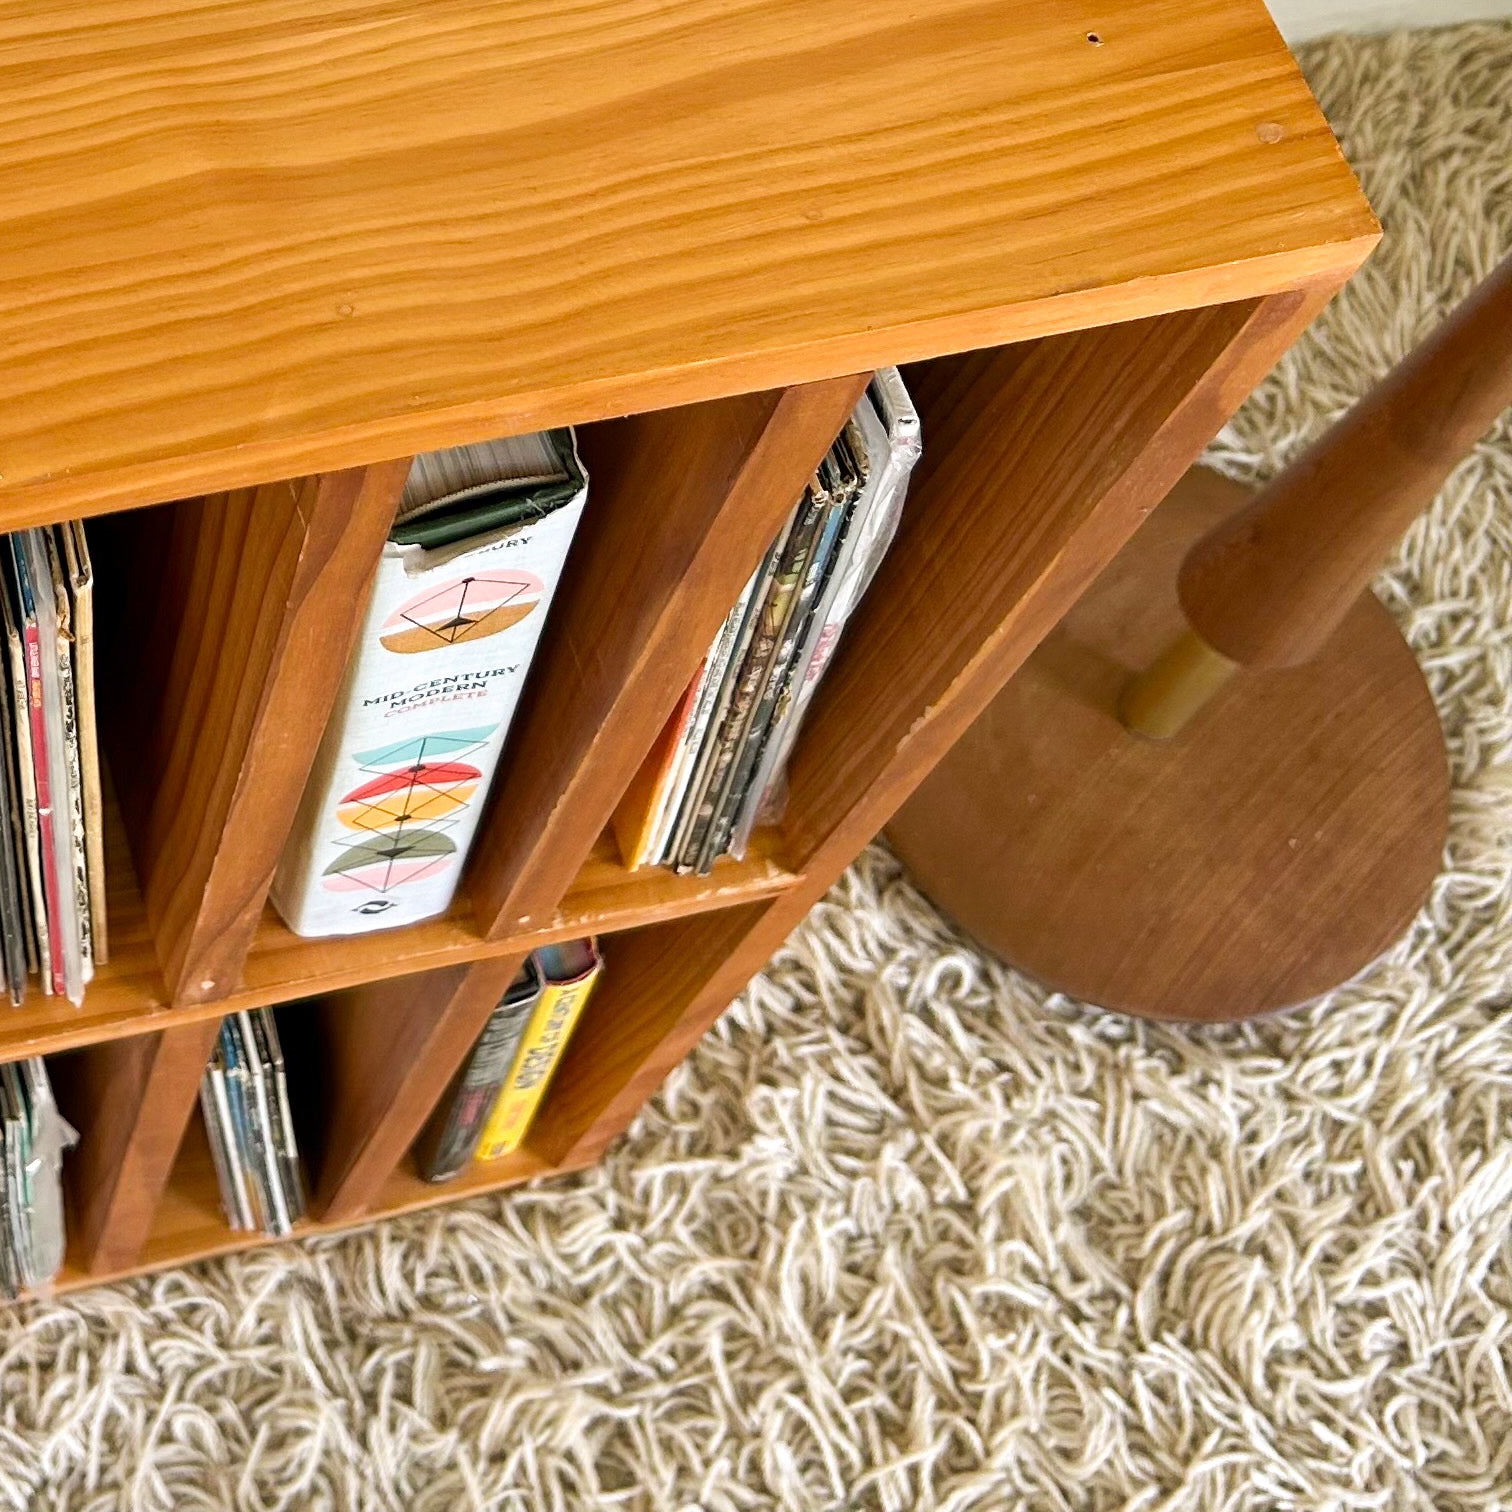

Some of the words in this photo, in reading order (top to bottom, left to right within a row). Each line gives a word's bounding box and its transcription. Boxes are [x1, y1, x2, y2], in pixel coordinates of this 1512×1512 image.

[362, 663, 521, 707] MID-CENTURY
[389, 680, 489, 709] MODERN
[383, 689, 489, 718] COMPLETE
